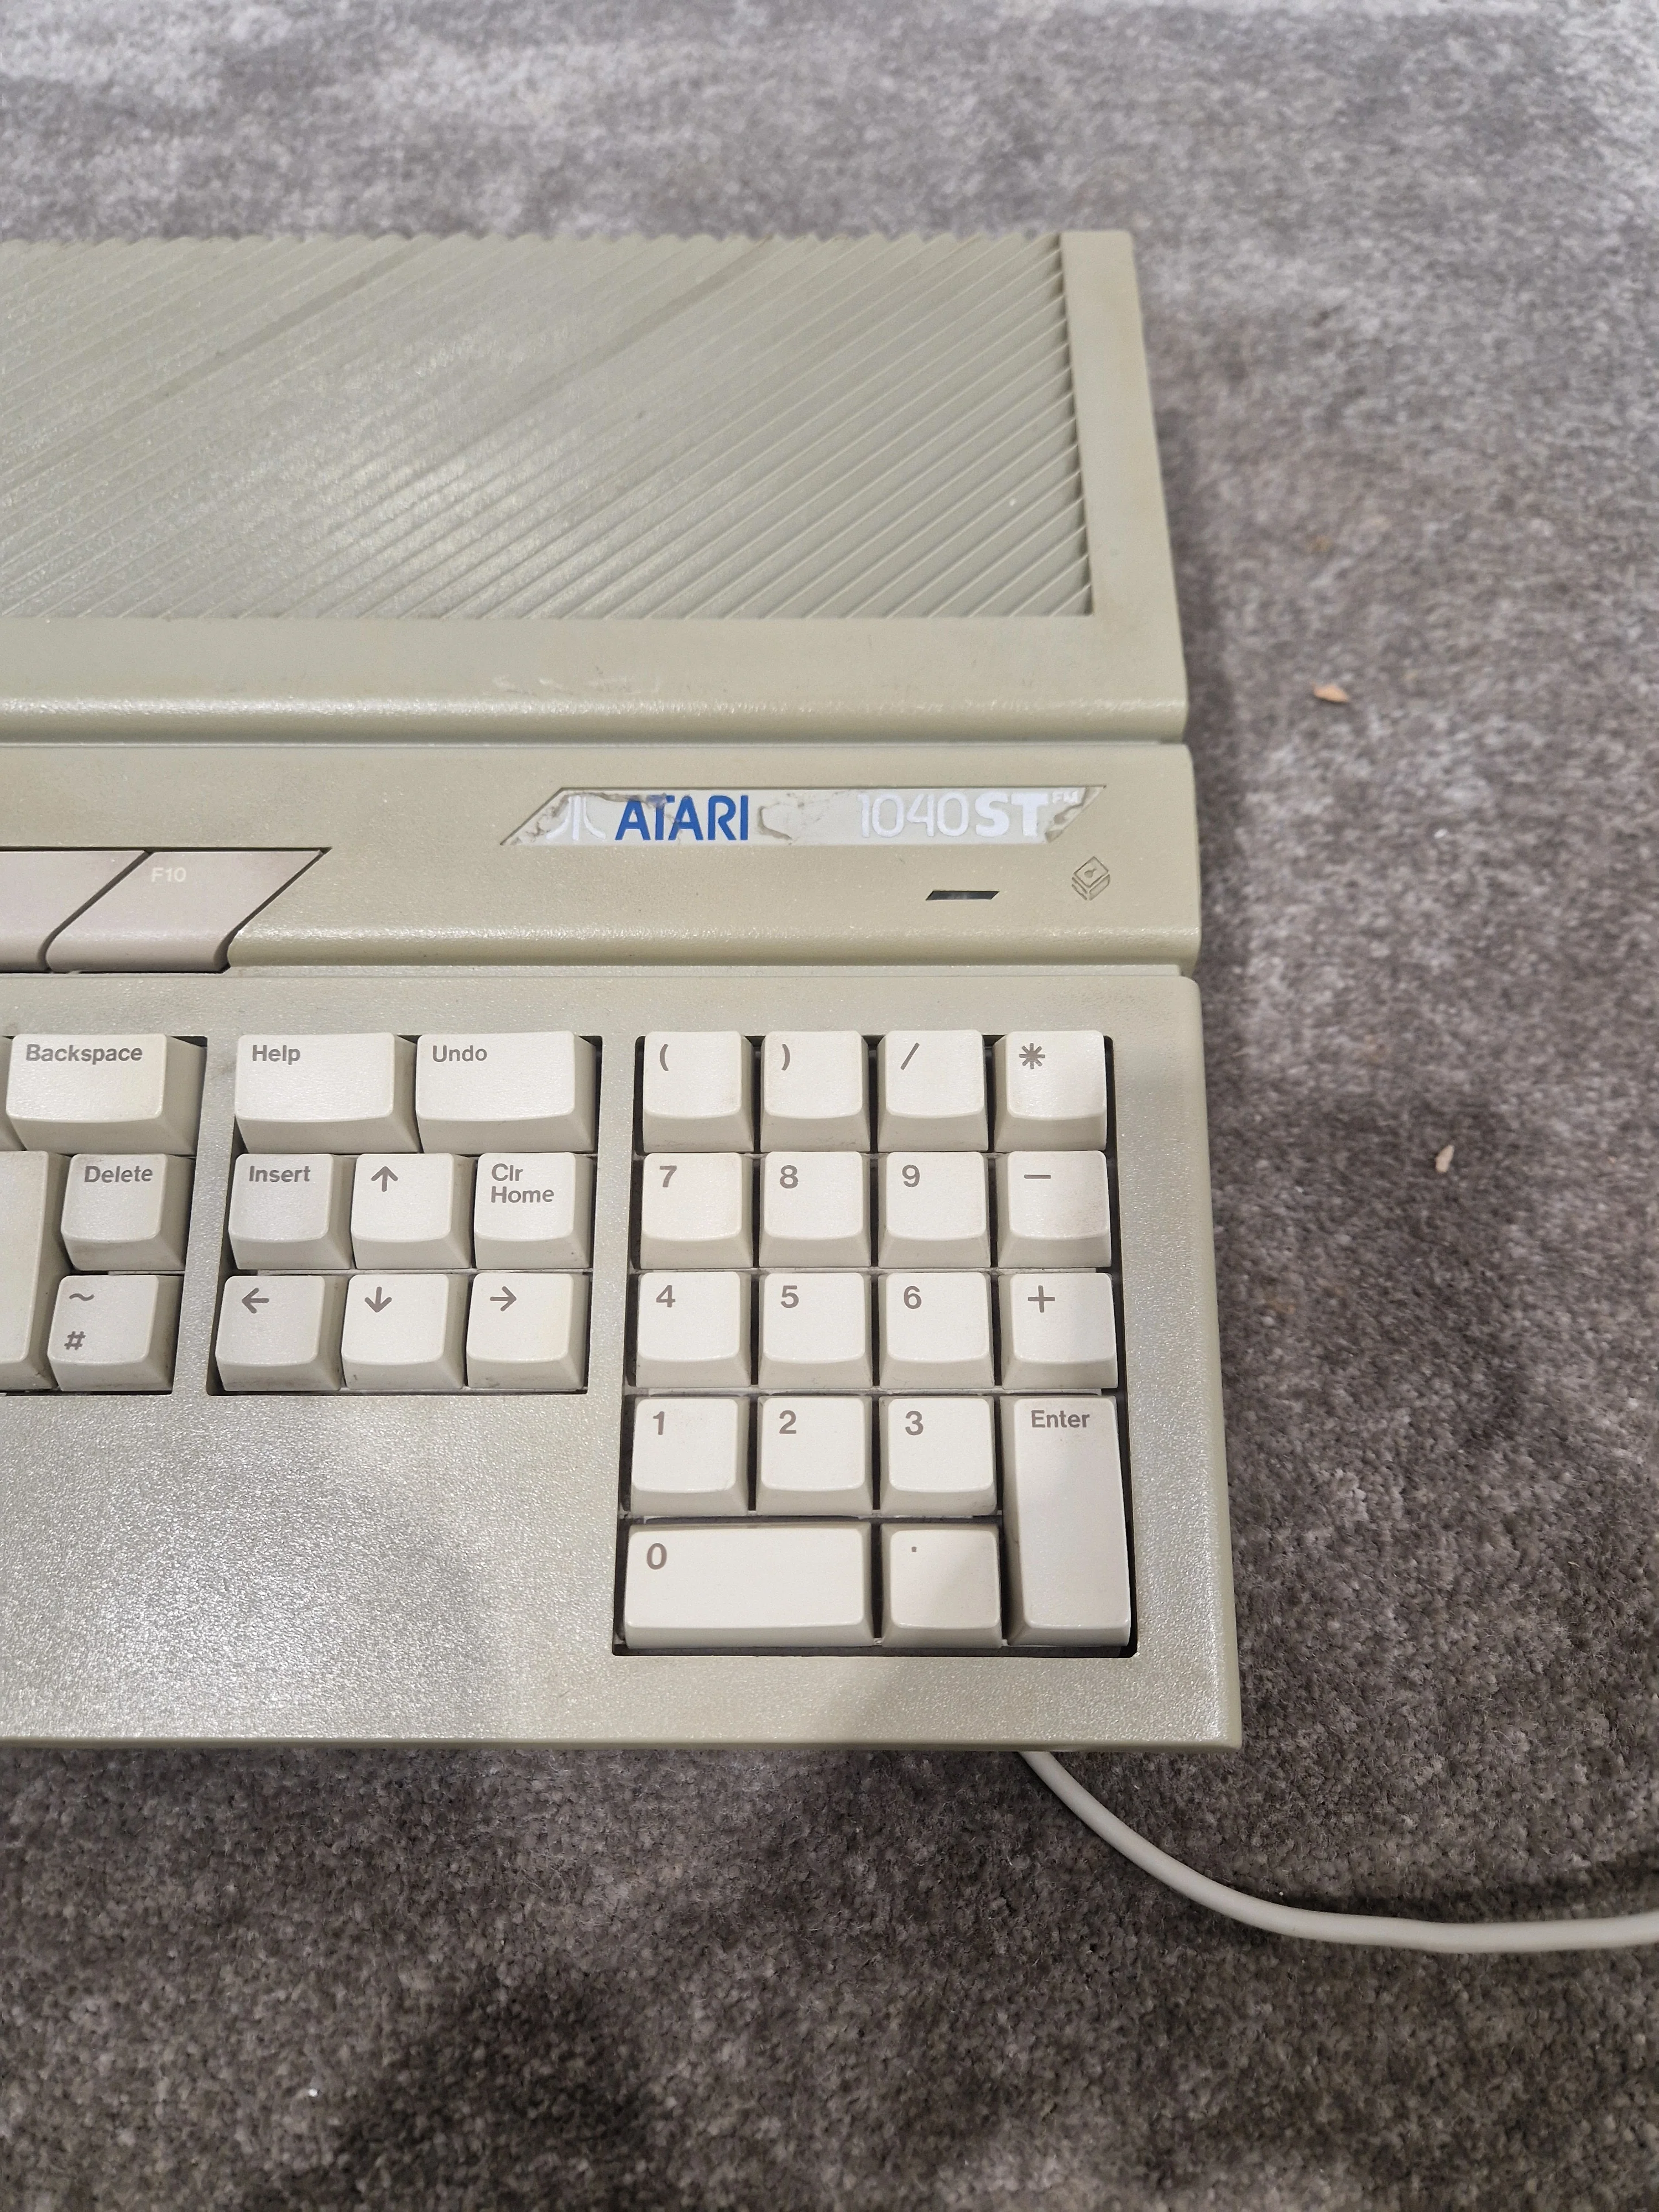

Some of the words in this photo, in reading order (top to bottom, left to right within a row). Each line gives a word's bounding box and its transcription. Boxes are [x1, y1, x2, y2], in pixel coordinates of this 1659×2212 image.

[615, 795, 749, 841] ATARI
[151, 867, 186, 883] F10
[26, 1044, 143, 1065] Backspace
[252, 1044, 301, 1065] Help
[432, 1045, 487, 1063] Undo
[84, 1165, 153, 1183] Delete
[249, 1165, 311, 1183] Insert
[491, 1163, 524, 1182] Clr
[659, 1165, 677, 1188] 7
[779, 1165, 799, 1189] 8
[902, 1164, 920, 1188] 9
[491, 1186, 555, 1203] Home
[656, 1285, 676, 1308] 4
[780, 1285, 799, 1309] 5
[903, 1285, 922, 1310] 6
[64, 1331, 86, 1350] #
[653, 1411, 665, 1436] 1
[779, 1410, 797, 1434] 2
[905, 1410, 924, 1436] 3
[1031, 1410, 1091, 1428] Enter
[646, 1543, 667, 1570] 0
